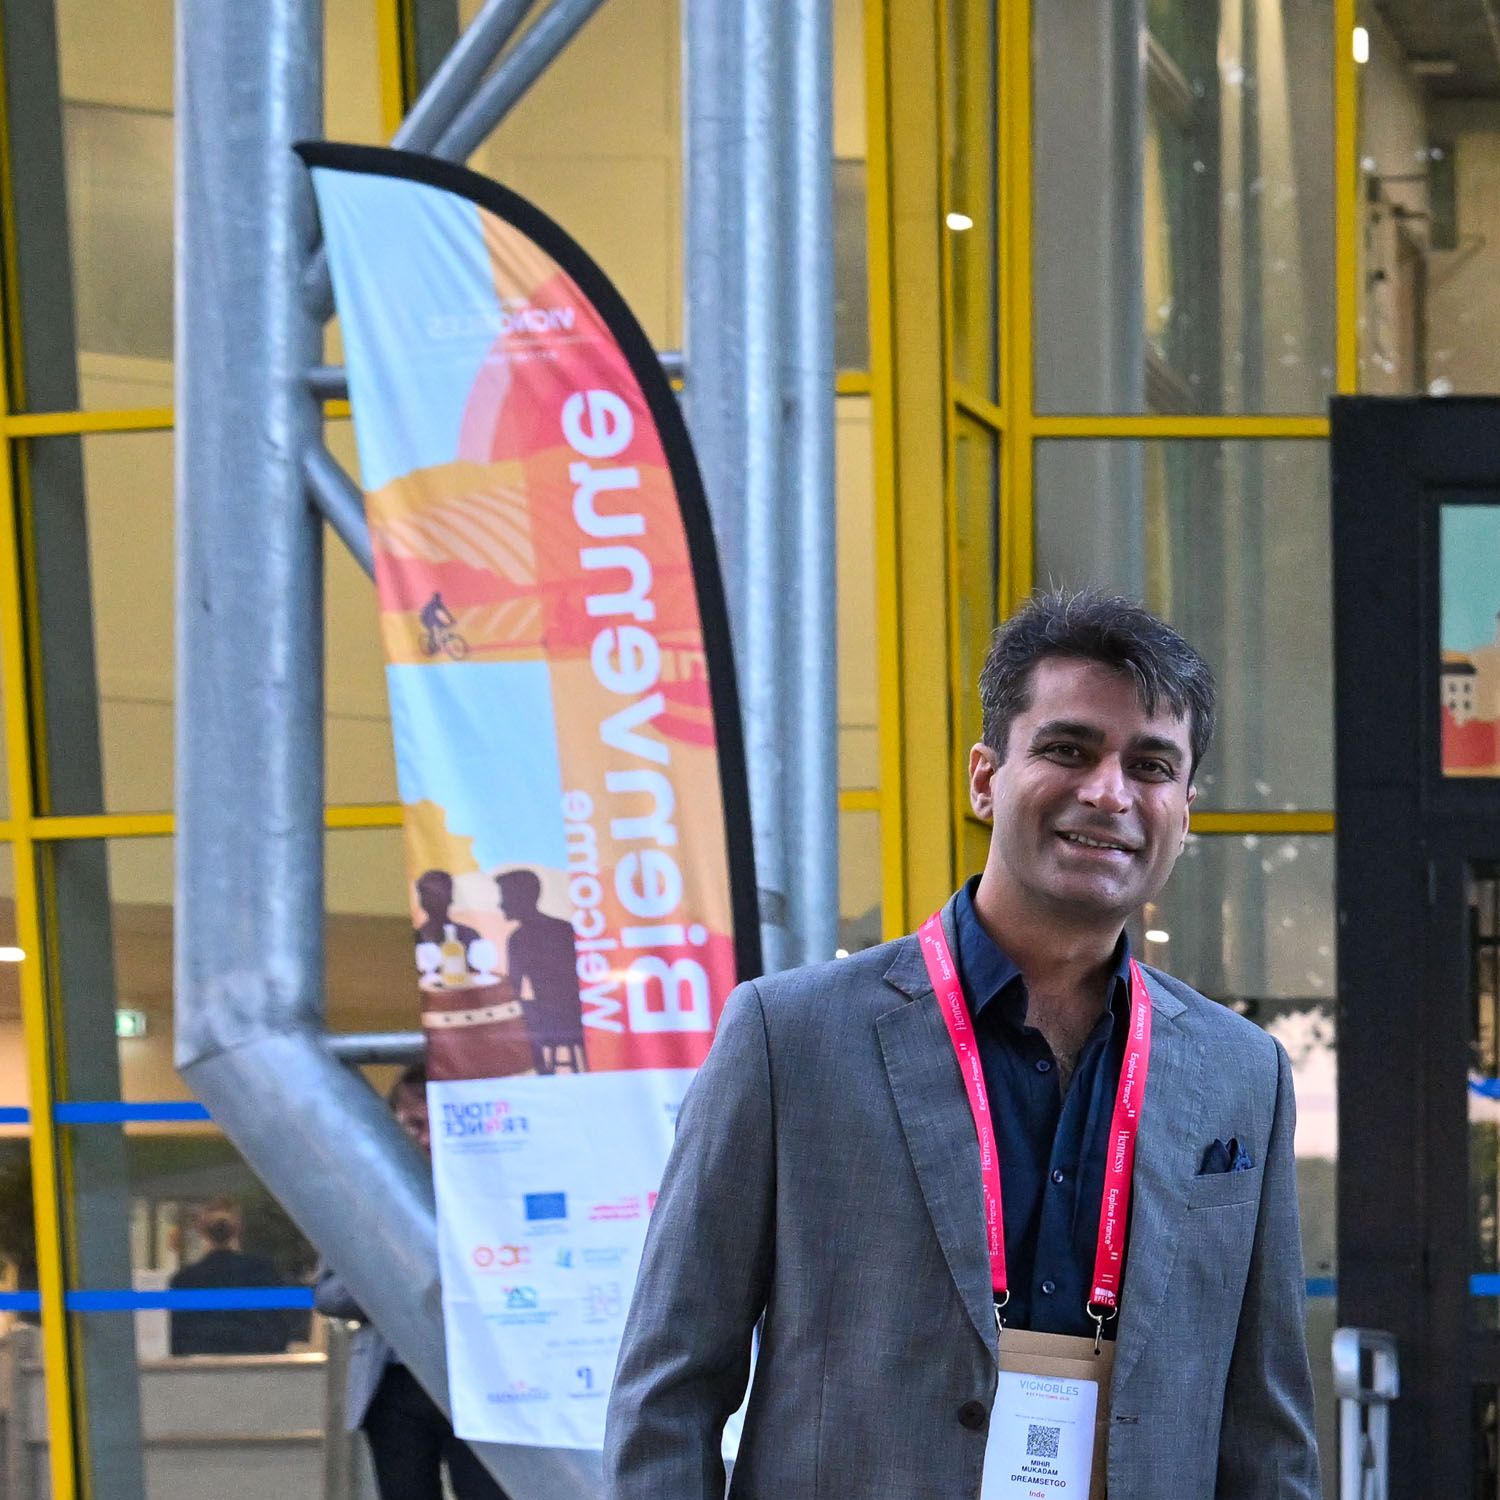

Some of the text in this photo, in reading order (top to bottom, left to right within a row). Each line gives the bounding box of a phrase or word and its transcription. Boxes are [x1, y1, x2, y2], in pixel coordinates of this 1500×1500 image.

[1112, 1130, 1130, 1174] Hennessy
[1107, 1188, 1119, 1217] Explore
[1019, 1379, 1079, 1396] VIGNOBLES
[1021, 1465, 1058, 1476] MUKADAM
[1010, 1474, 1066, 1488] DREAMSETGO
[1029, 1490, 1045, 1499] Inde
